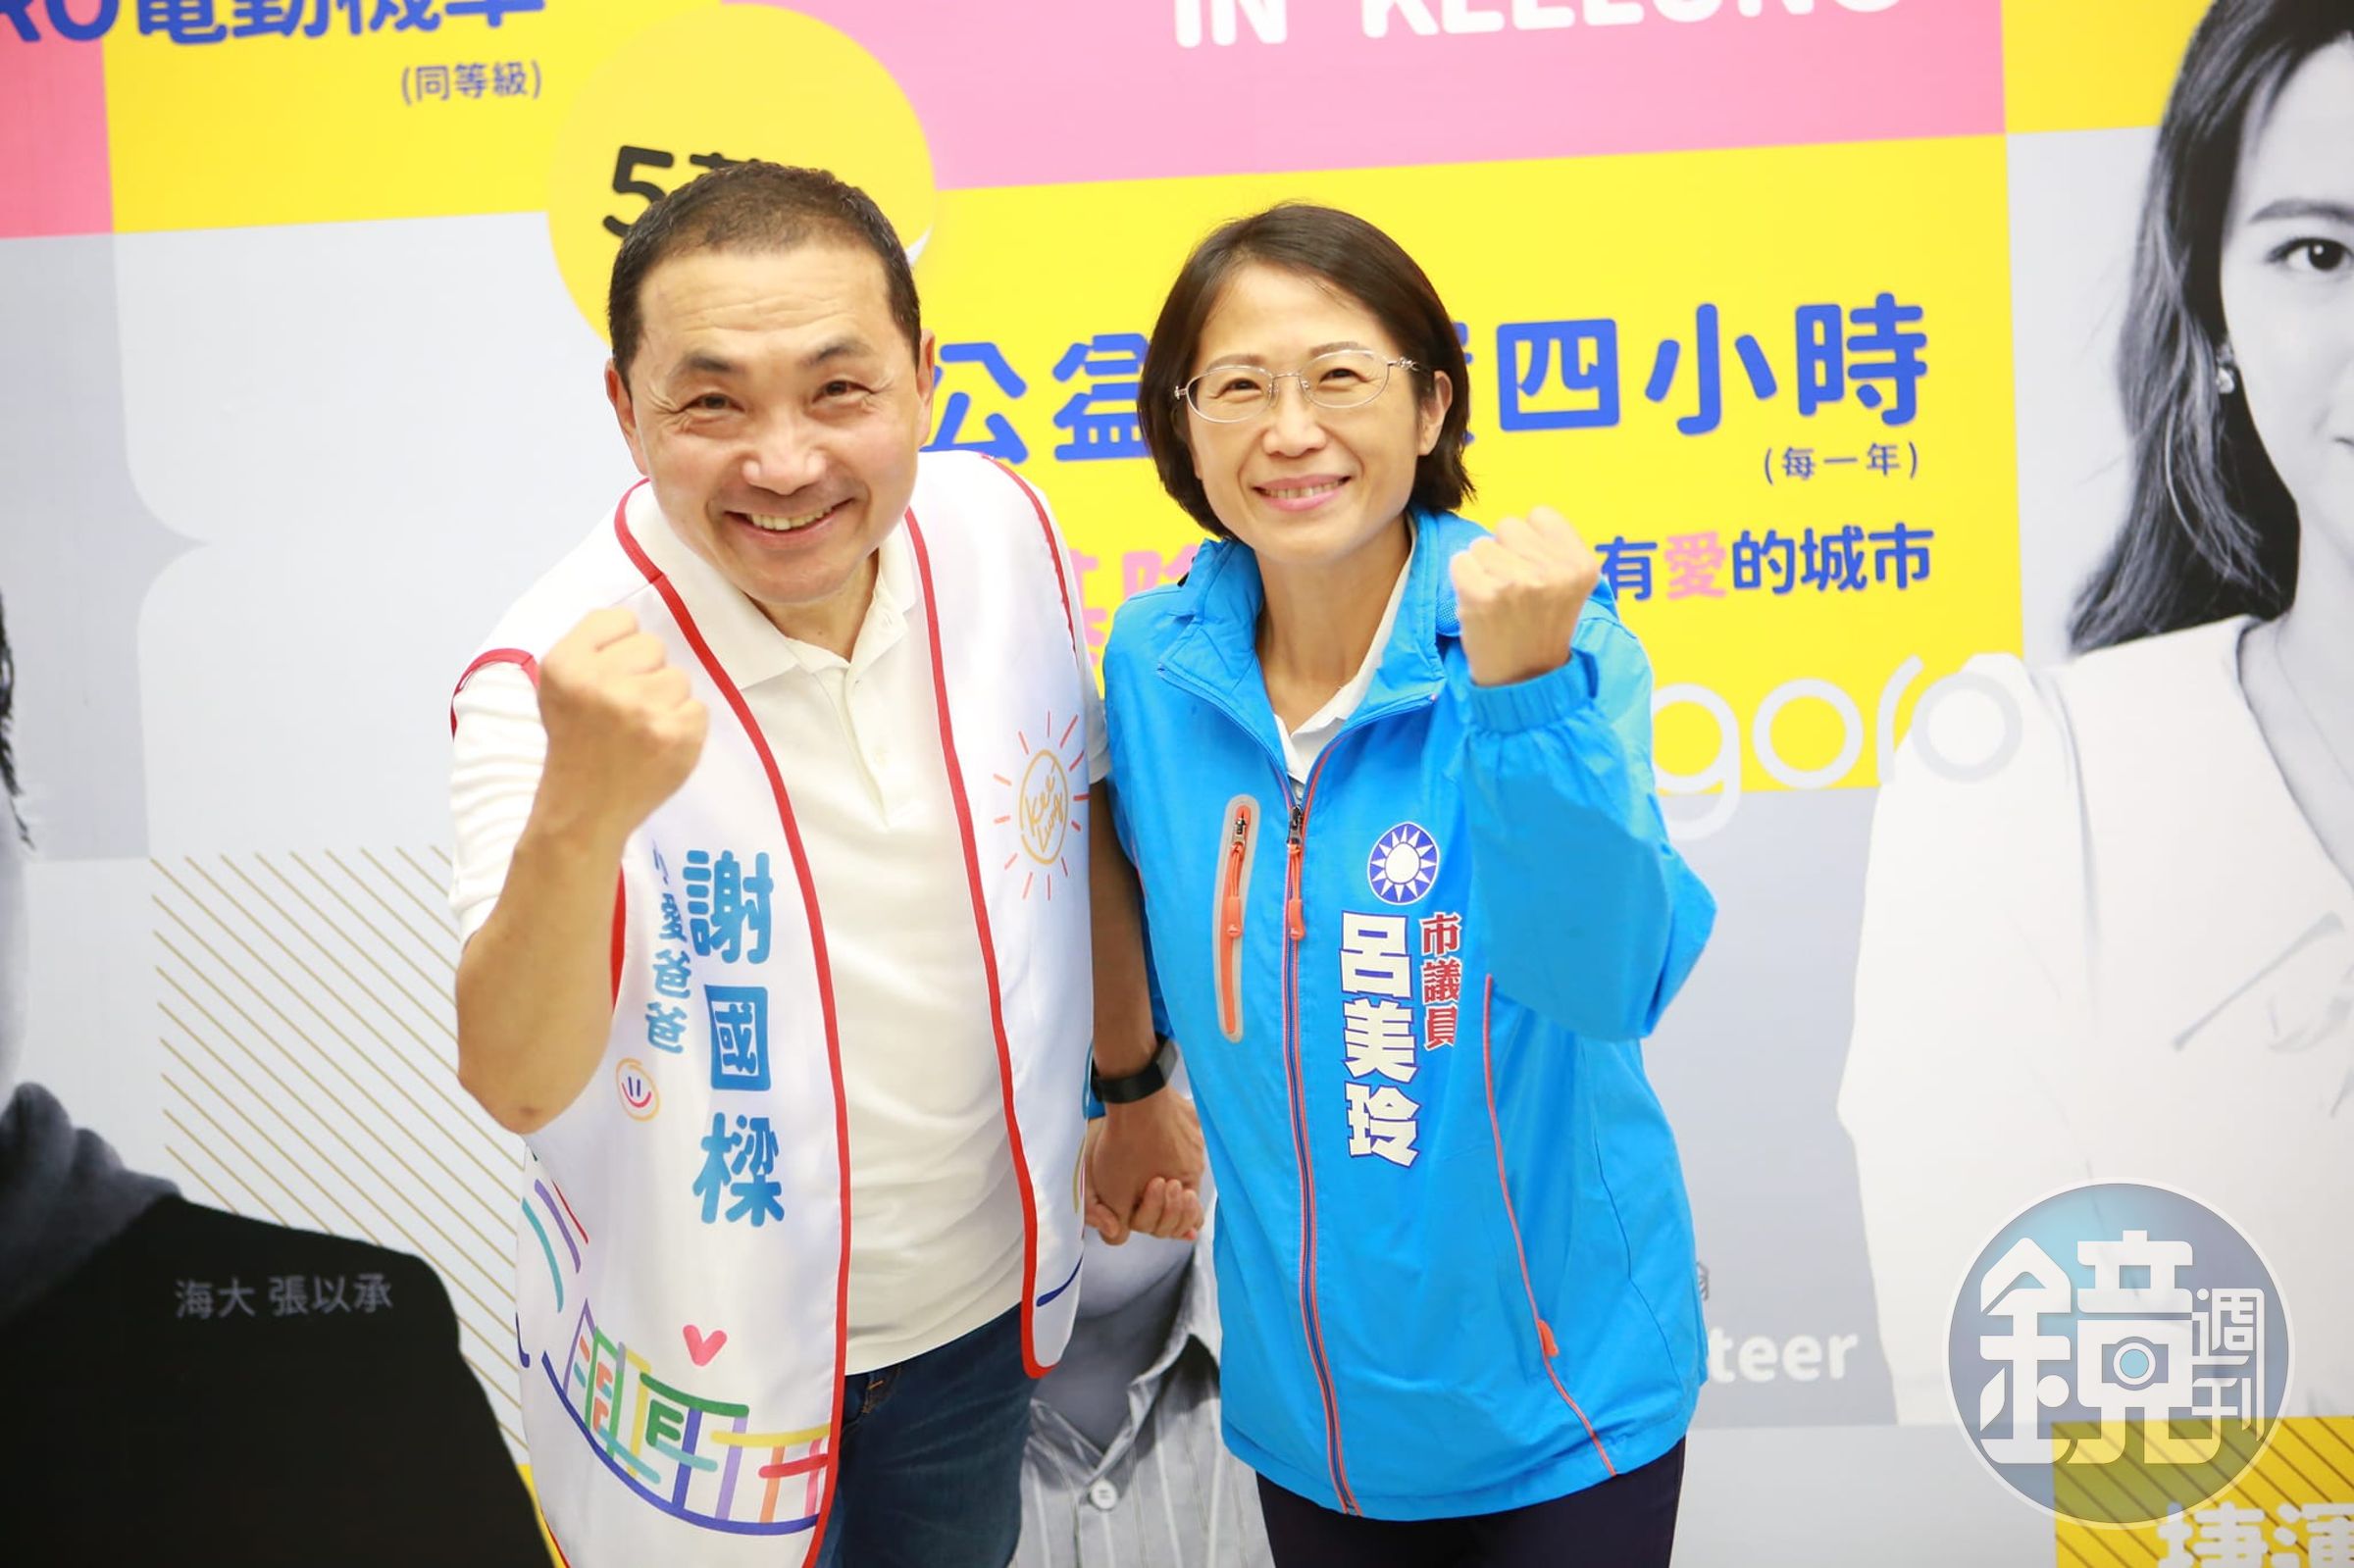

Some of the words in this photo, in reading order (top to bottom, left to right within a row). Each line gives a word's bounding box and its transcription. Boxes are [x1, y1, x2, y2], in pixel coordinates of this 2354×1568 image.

[401, 60, 542, 105] (同等級)
[1456, 292, 1928, 435] 四小時
[1764, 441, 1919, 484] (每一年)
[683, 849, 785, 1228] 謝國樑
[1339, 910, 1422, 1169] 呂美玲
[1419, 911, 1462, 1051] 市議員
[175, 1277, 257, 1320] 海大
[267, 1273, 393, 1318] 張以承
